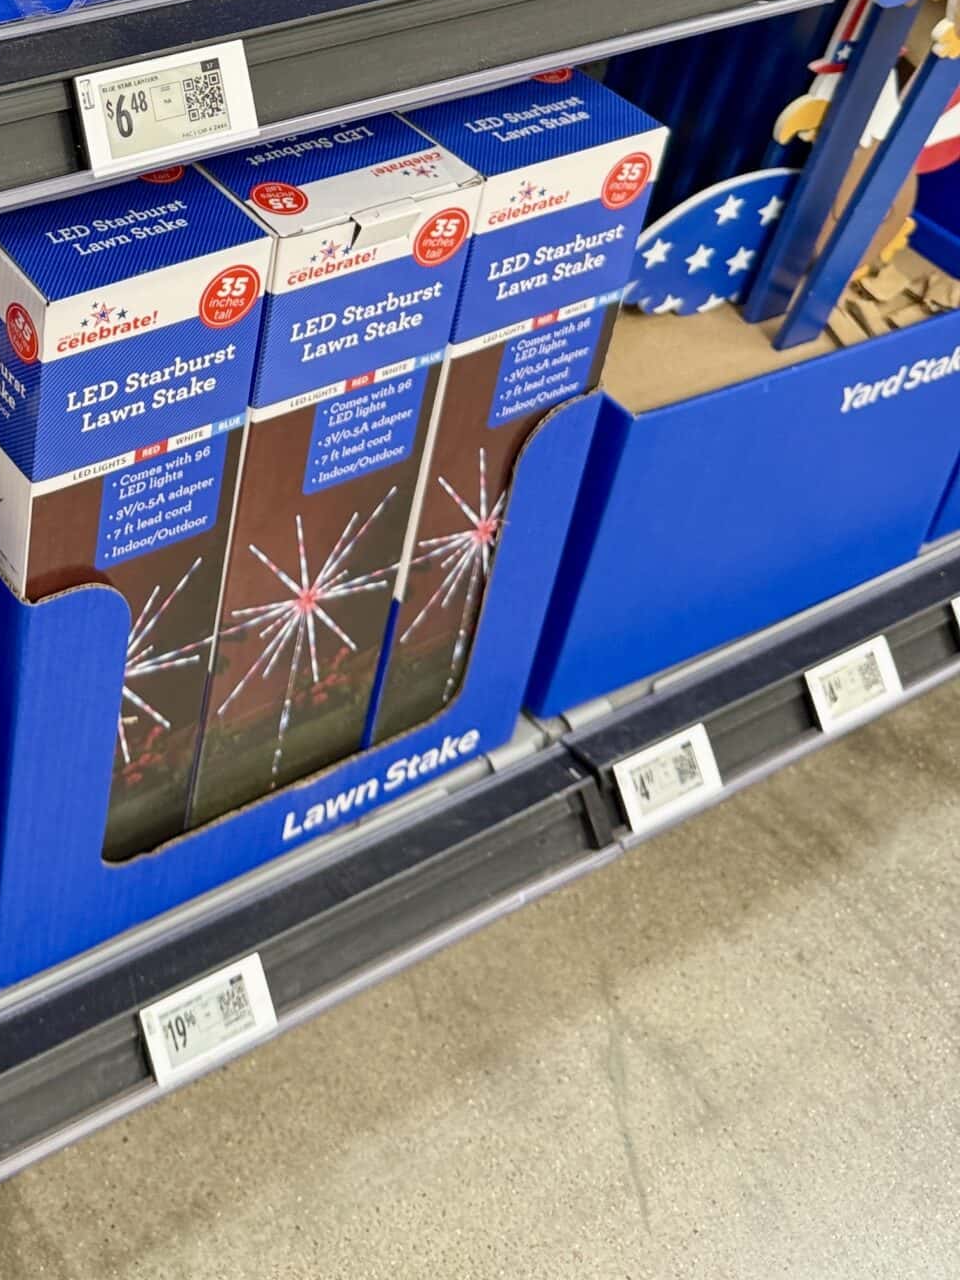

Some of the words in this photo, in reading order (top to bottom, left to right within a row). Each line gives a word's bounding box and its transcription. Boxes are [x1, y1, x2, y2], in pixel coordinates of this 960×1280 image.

[117, 80, 133, 91] STAR
[134, 75, 159, 87] LANTERN
[464, 116, 504, 133] LED
[505, 95, 585, 124] Starburst
[492, 122, 544, 143] Lawn
[540, 109, 591, 130] Stake
[246, 137, 334, 166] Starburst
[333, 125, 375, 144] LED
[617, 162, 644, 181] 35
[45, 227, 90, 245] LED
[92, 199, 188, 233] Starburst
[487, 190, 570, 226] celebrate!
[73, 235, 132, 256] Lawn
[133, 217, 189, 240] Stake
[430, 218, 461, 238] 35
[287, 247, 378, 286] celebrate!
[487, 252, 530, 281] LED
[533, 223, 626, 266] Starburst
[217, 277, 249, 297] 35
[496, 271, 548, 300] Lawn
[552, 252, 606, 282] Stake
[208, 295, 246, 308] inches
[214, 307, 233, 320] tall
[291, 313, 336, 342] LED
[342, 281, 443, 326] Starburst
[57, 310, 159, 353] celebrate!
[301, 331, 359, 362] Lawn
[364, 311, 424, 341] Stake
[66, 381, 118, 412] LED
[125, 343, 236, 393] Starburst
[840, 365, 907, 413] Yard
[81, 403, 145, 433] Lawn
[151, 376, 217, 409] Stake
[72, 468, 91, 481] LED
[93, 456, 127, 474] LIGHTS
[141, 445, 161, 458] RED
[175, 430, 205, 445] WHITE
[218, 416, 241, 431] BLUE
[119, 464, 162, 486] Comes
[165, 453, 192, 470] with
[195, 446, 211, 462] 96
[118, 482, 146, 500] LED
[149, 470, 184, 491] lights
[168, 477, 214, 501] adapter
[111, 515, 208, 558] Indoor/Outdoor
[113, 530, 121, 540] 7
[124, 522, 134, 535] ft
[137, 514, 162, 531] lead
[165, 501, 192, 520] cord
[282, 777, 379, 841] Lawn
[383, 729, 480, 791] Stake
